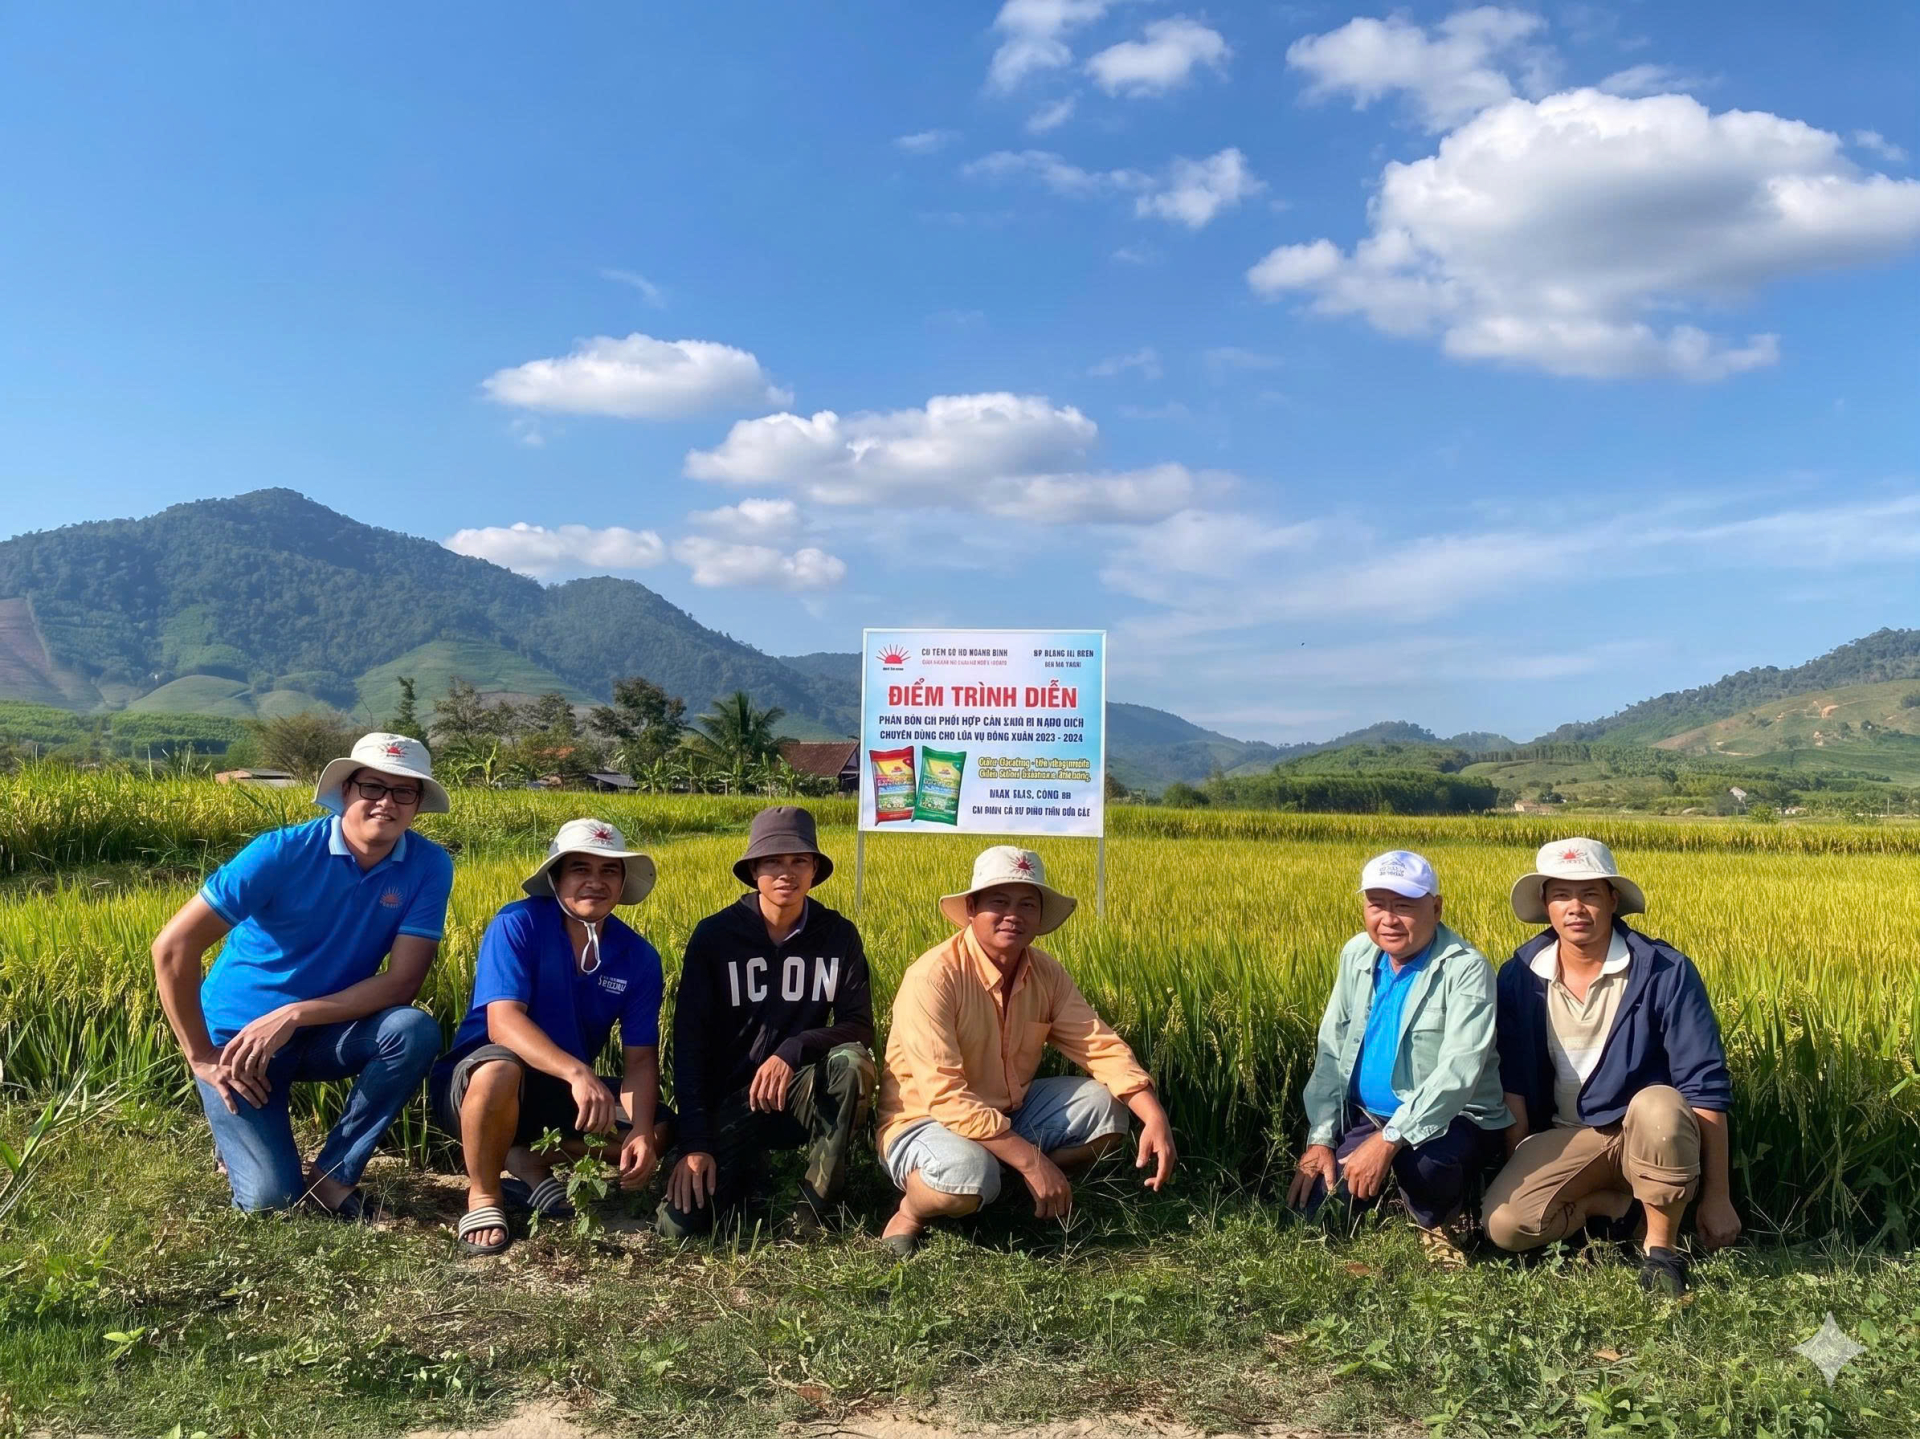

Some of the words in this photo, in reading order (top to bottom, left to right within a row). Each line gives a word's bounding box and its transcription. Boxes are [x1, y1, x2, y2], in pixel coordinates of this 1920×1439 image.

[888, 677, 944, 707] ĐIỂM
[951, 681, 1017, 708] TRÌNH
[1025, 679, 1078, 709] DIỄN
[961, 715, 981, 728] HỢP
[880, 729, 912, 740] CHUYÊN
[938, 731, 956, 741] CHO
[974, 731, 985, 743] VỤ
[1035, 732, 1056, 742] 2023
[1062, 733, 1083, 743] 2024
[728, 956, 840, 1007] ICON
